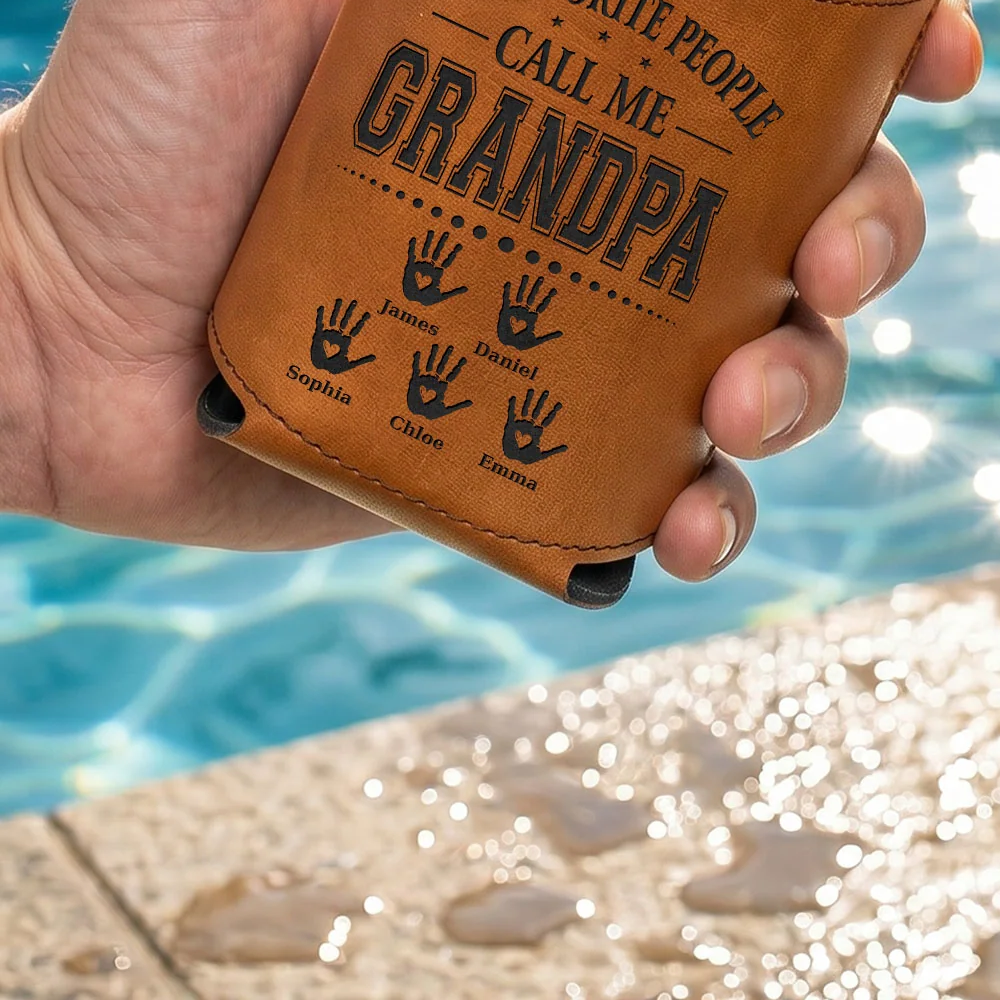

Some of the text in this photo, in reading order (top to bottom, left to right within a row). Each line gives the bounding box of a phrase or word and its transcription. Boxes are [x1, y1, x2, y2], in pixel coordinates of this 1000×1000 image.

[495, 25, 676, 138] CALL ME
[664, 15, 784, 139] PEOPLE
[353, 39, 729, 303] GRANDPA
[377, 299, 440, 336] James
[473, 341, 539, 380] Daniel
[286, 365, 352, 405] Sophia
[389, 415, 444, 450] Chloe
[478, 454, 539, 491] Emma
